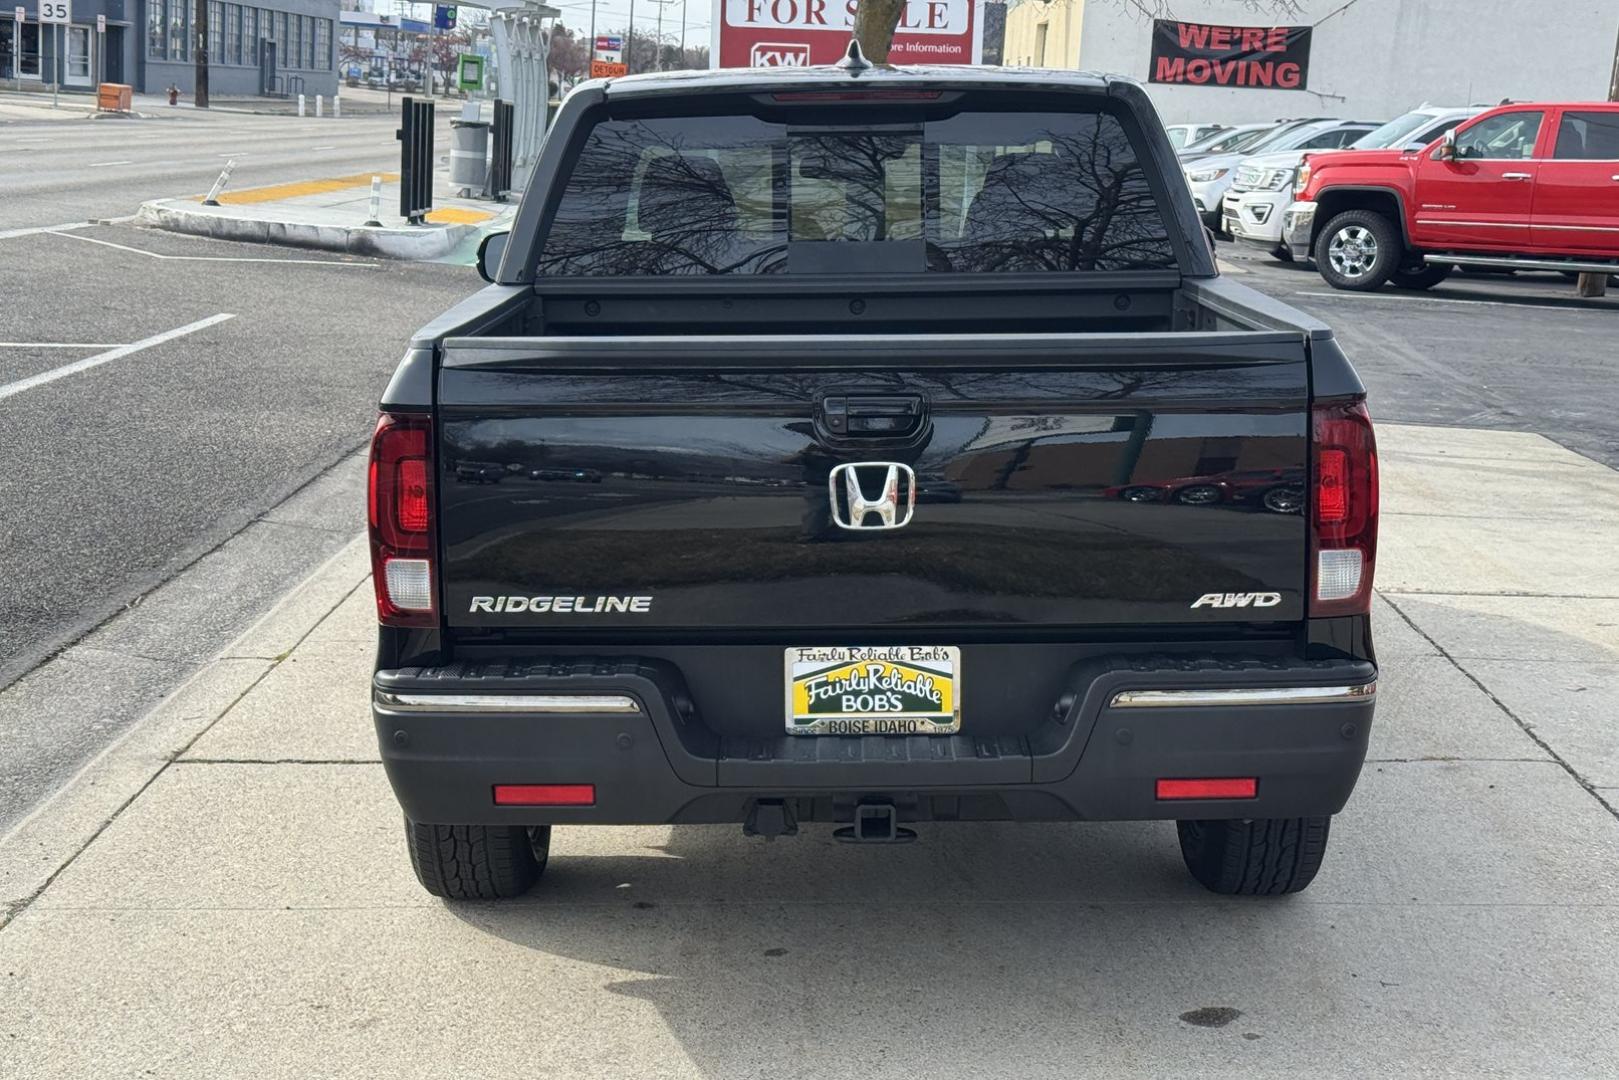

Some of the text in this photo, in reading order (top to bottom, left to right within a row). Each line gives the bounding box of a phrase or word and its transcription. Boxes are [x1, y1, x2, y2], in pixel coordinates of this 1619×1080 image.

[43, 3, 67, 19] 35
[744, 0, 949, 29] FOR SLE
[1178, 23, 1289, 52] WE'RE
[906, 42, 961, 54] Information
[755, 51, 806, 67] KW
[594, 64, 625, 75] DETOUR
[1156, 56, 1300, 88] MOVING
[469, 596, 653, 613] RIDGELINE
[1190, 592, 1282, 608] AWD
[796, 647, 950, 662] Fairly Reliable Bob's
[807, 664, 942, 705] Fairly Reliable
[842, 691, 904, 713] BOB'S
[829, 719, 917, 734] BOISE IDAHO
